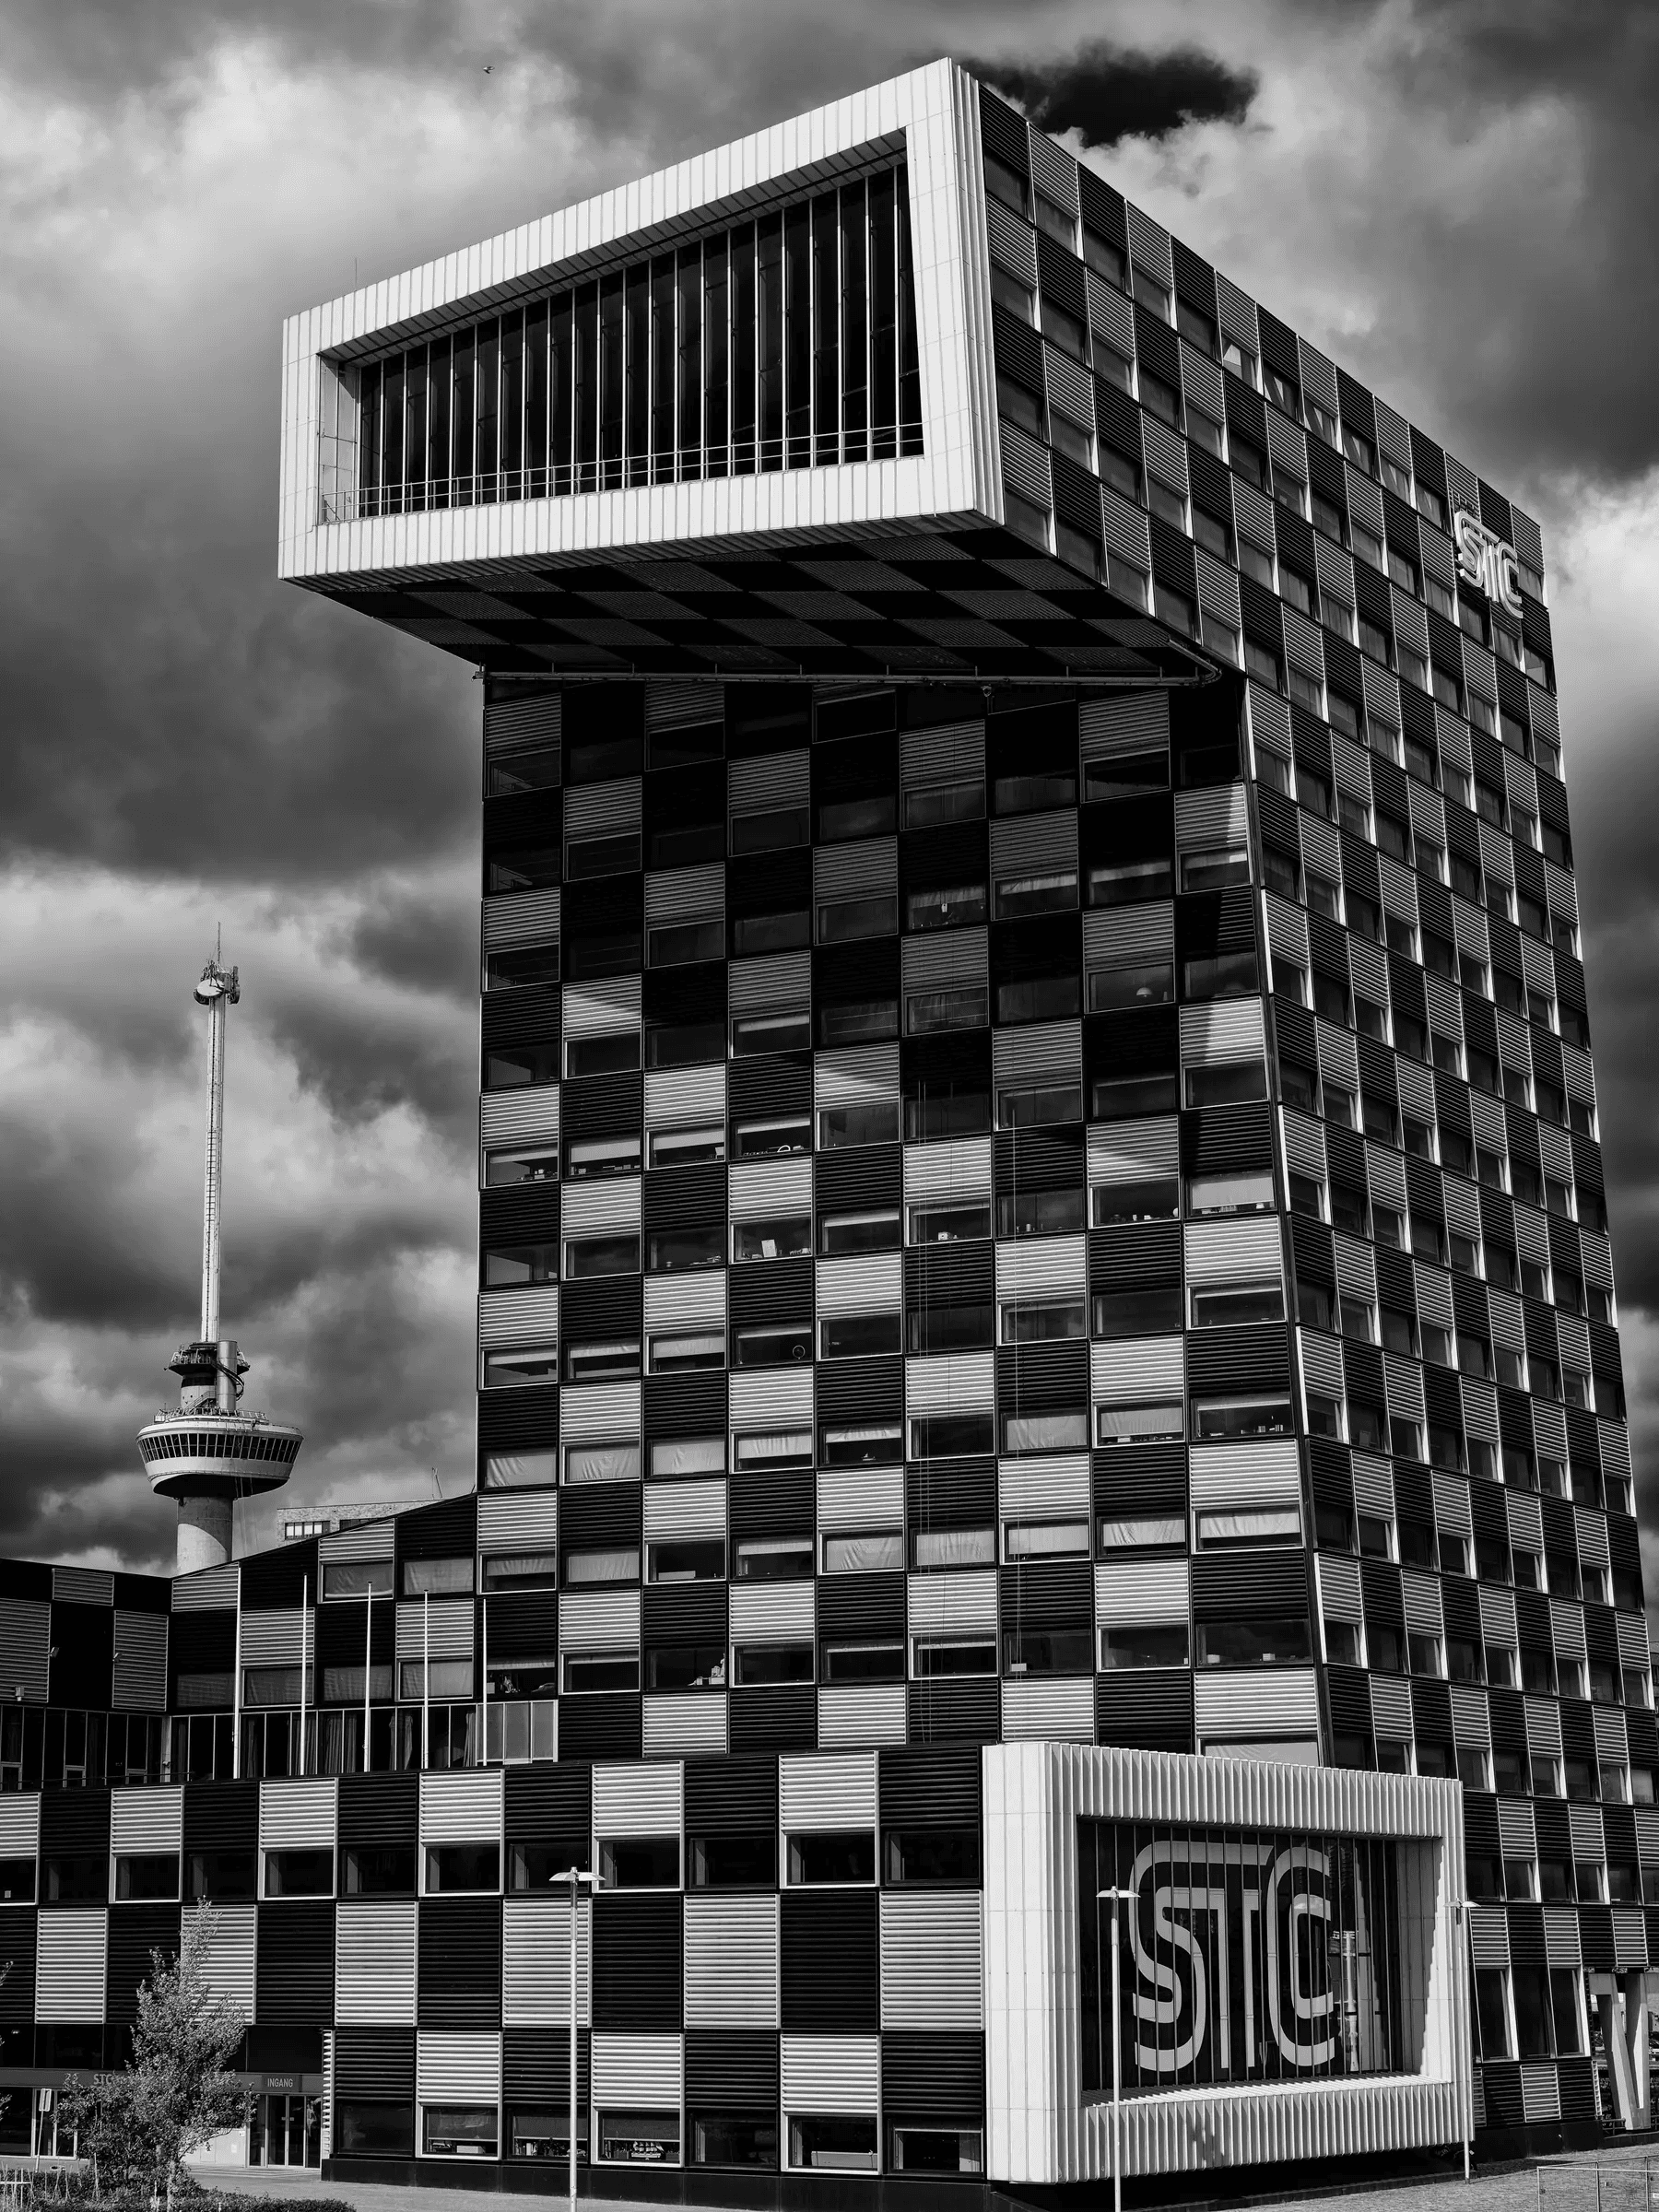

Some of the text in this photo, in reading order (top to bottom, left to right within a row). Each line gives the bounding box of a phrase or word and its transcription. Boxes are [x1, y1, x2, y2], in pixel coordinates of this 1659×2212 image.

[1453, 511, 1524, 619] STC
[1128, 1840, 1335, 2073] STC
[267, 2077, 294, 2088] INGANG
